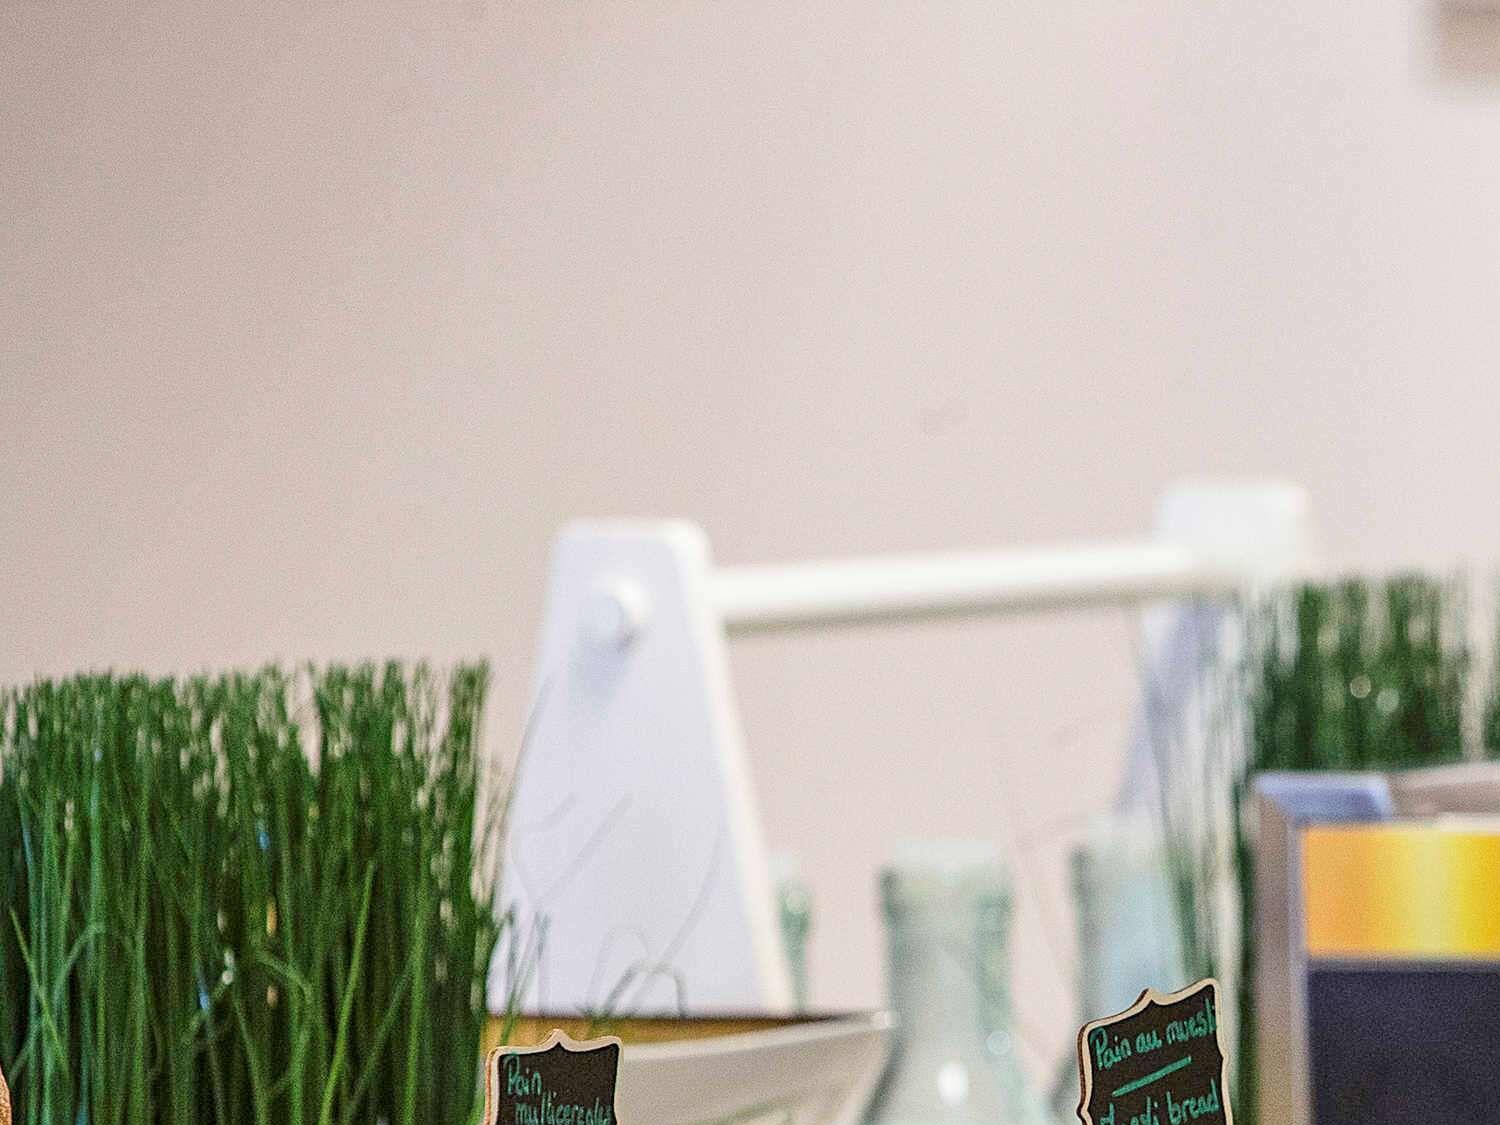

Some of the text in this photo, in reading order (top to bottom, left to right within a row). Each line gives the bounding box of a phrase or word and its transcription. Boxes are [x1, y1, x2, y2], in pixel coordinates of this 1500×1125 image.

[1090, 1026, 1132, 1071] Pain
[1135, 1030, 1163, 1053] au
[504, 1052, 542, 1096] Pain
